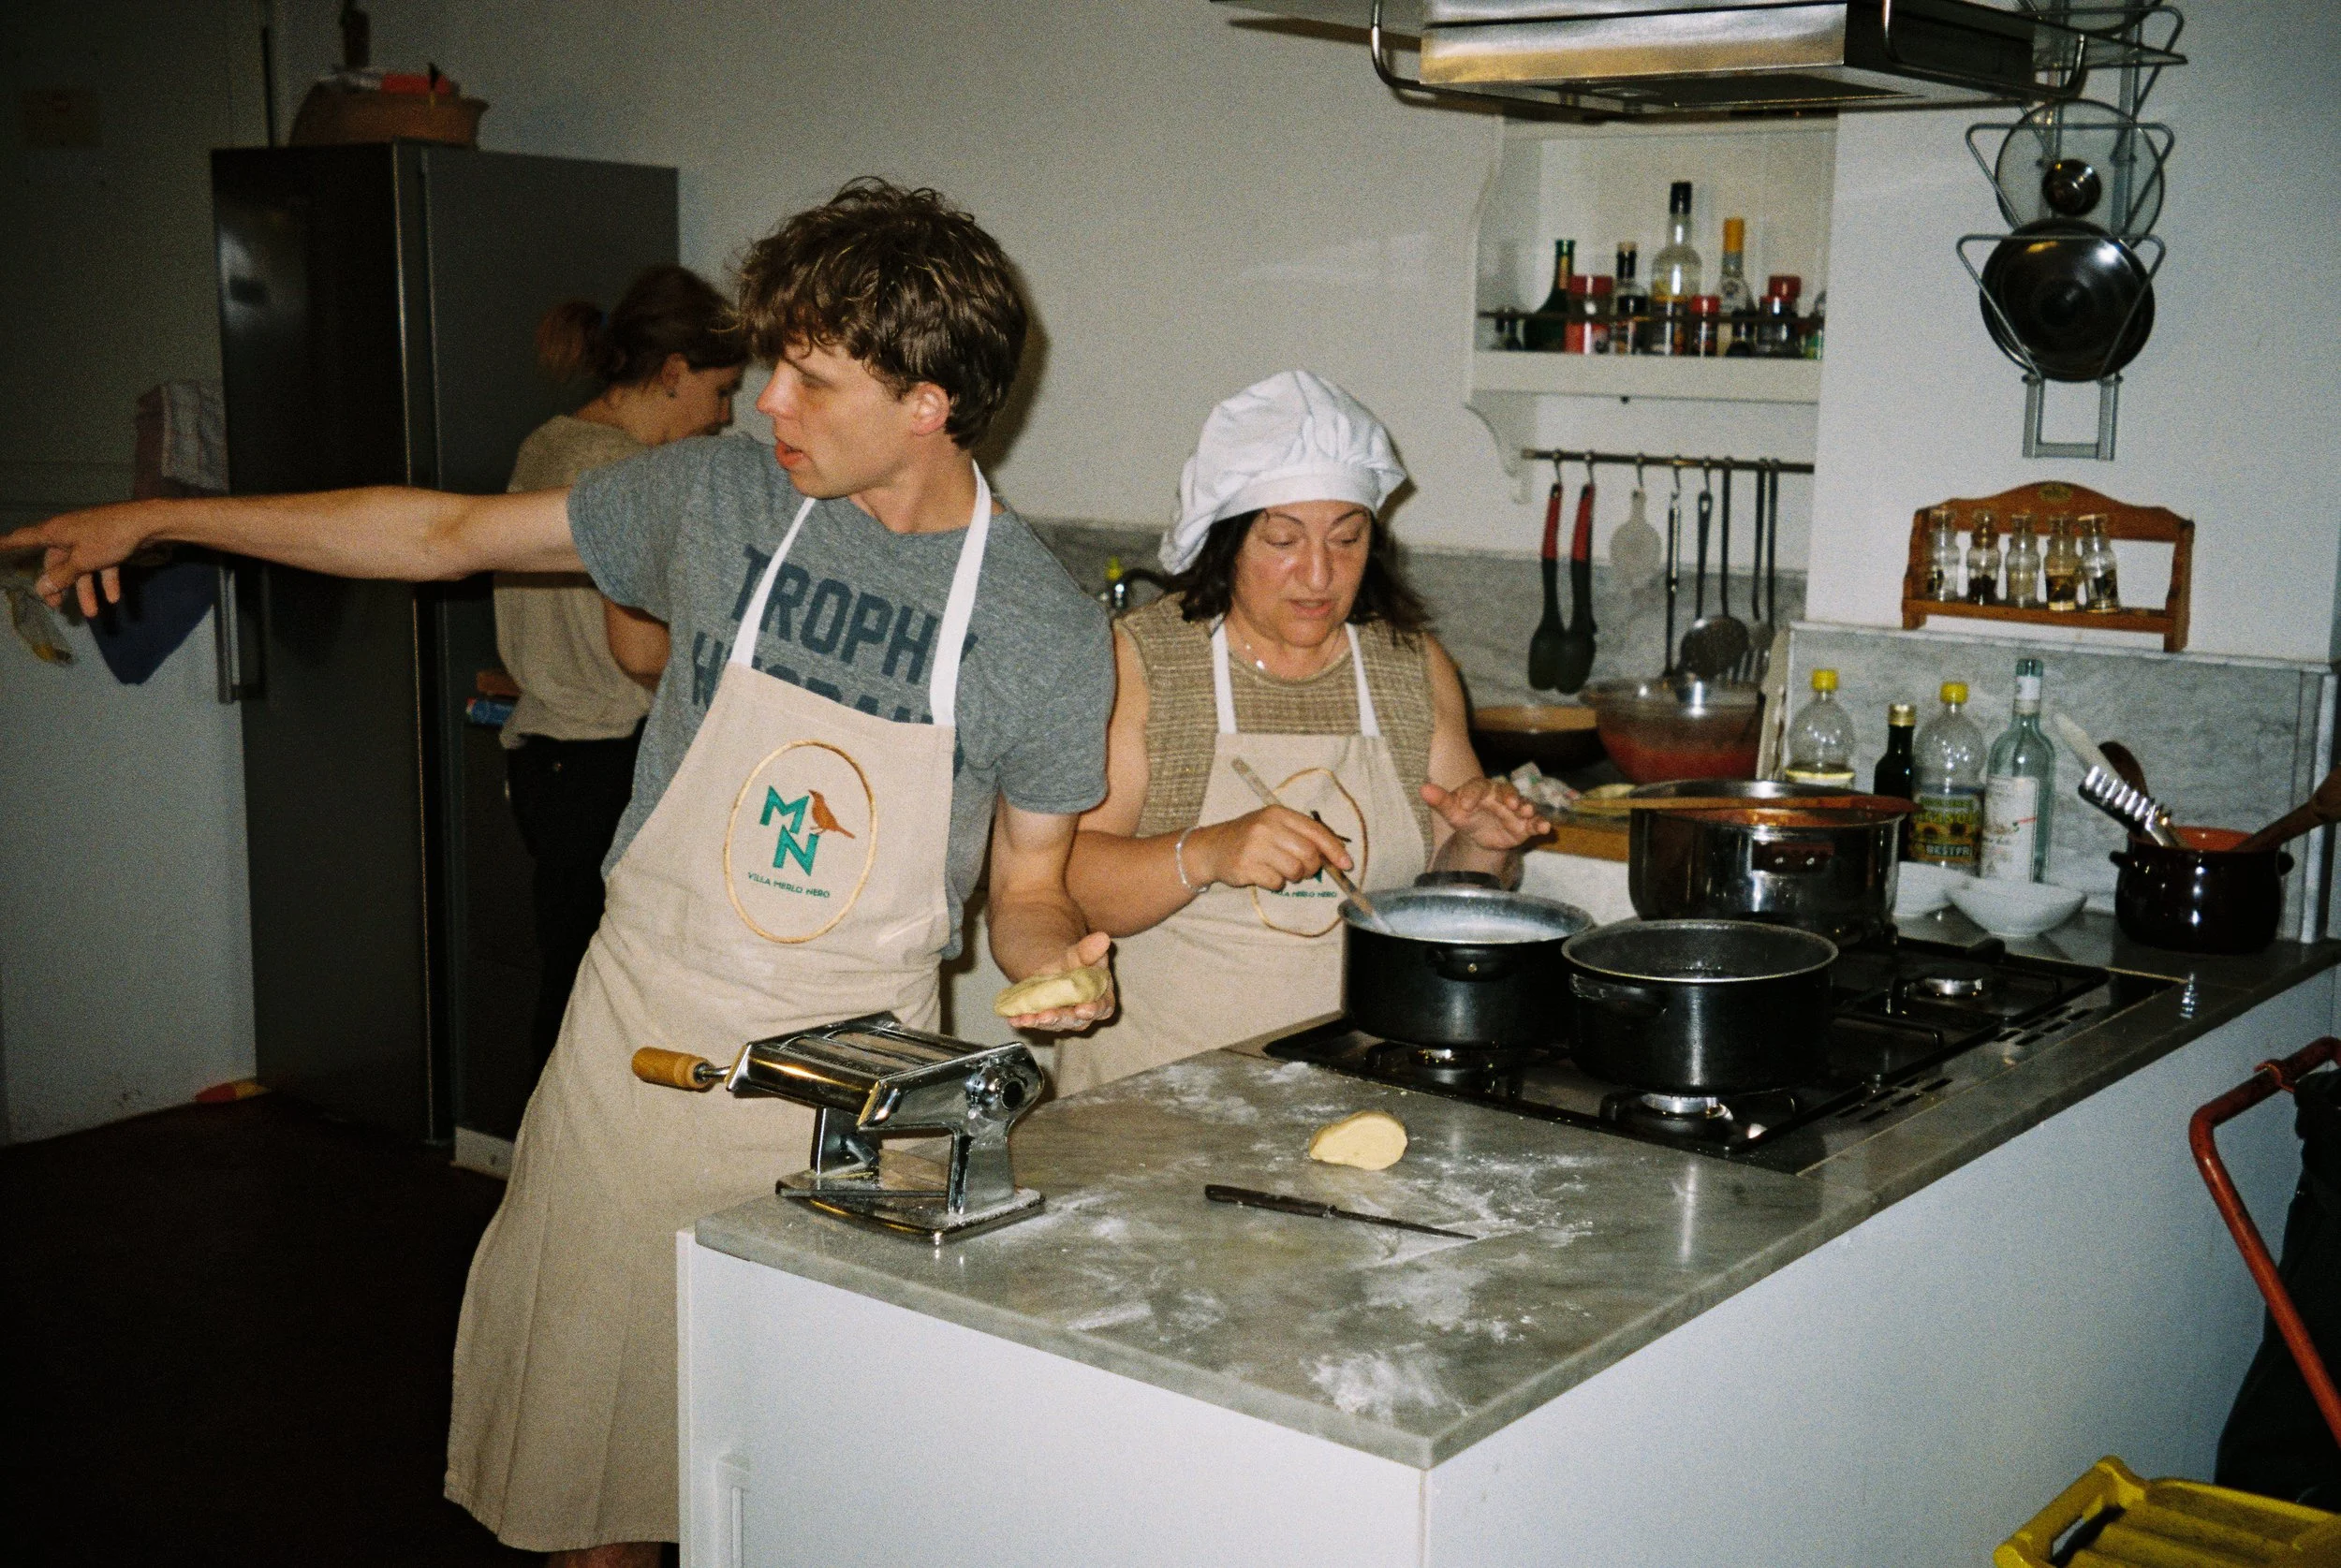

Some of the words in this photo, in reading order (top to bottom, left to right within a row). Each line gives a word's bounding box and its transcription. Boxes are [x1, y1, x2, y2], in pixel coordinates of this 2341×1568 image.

[731, 544, 979, 685] TROPH
[748, 872, 771, 886] VILLA
[773, 880, 803, 894] MERLO
[805, 887, 831, 899] NERO
